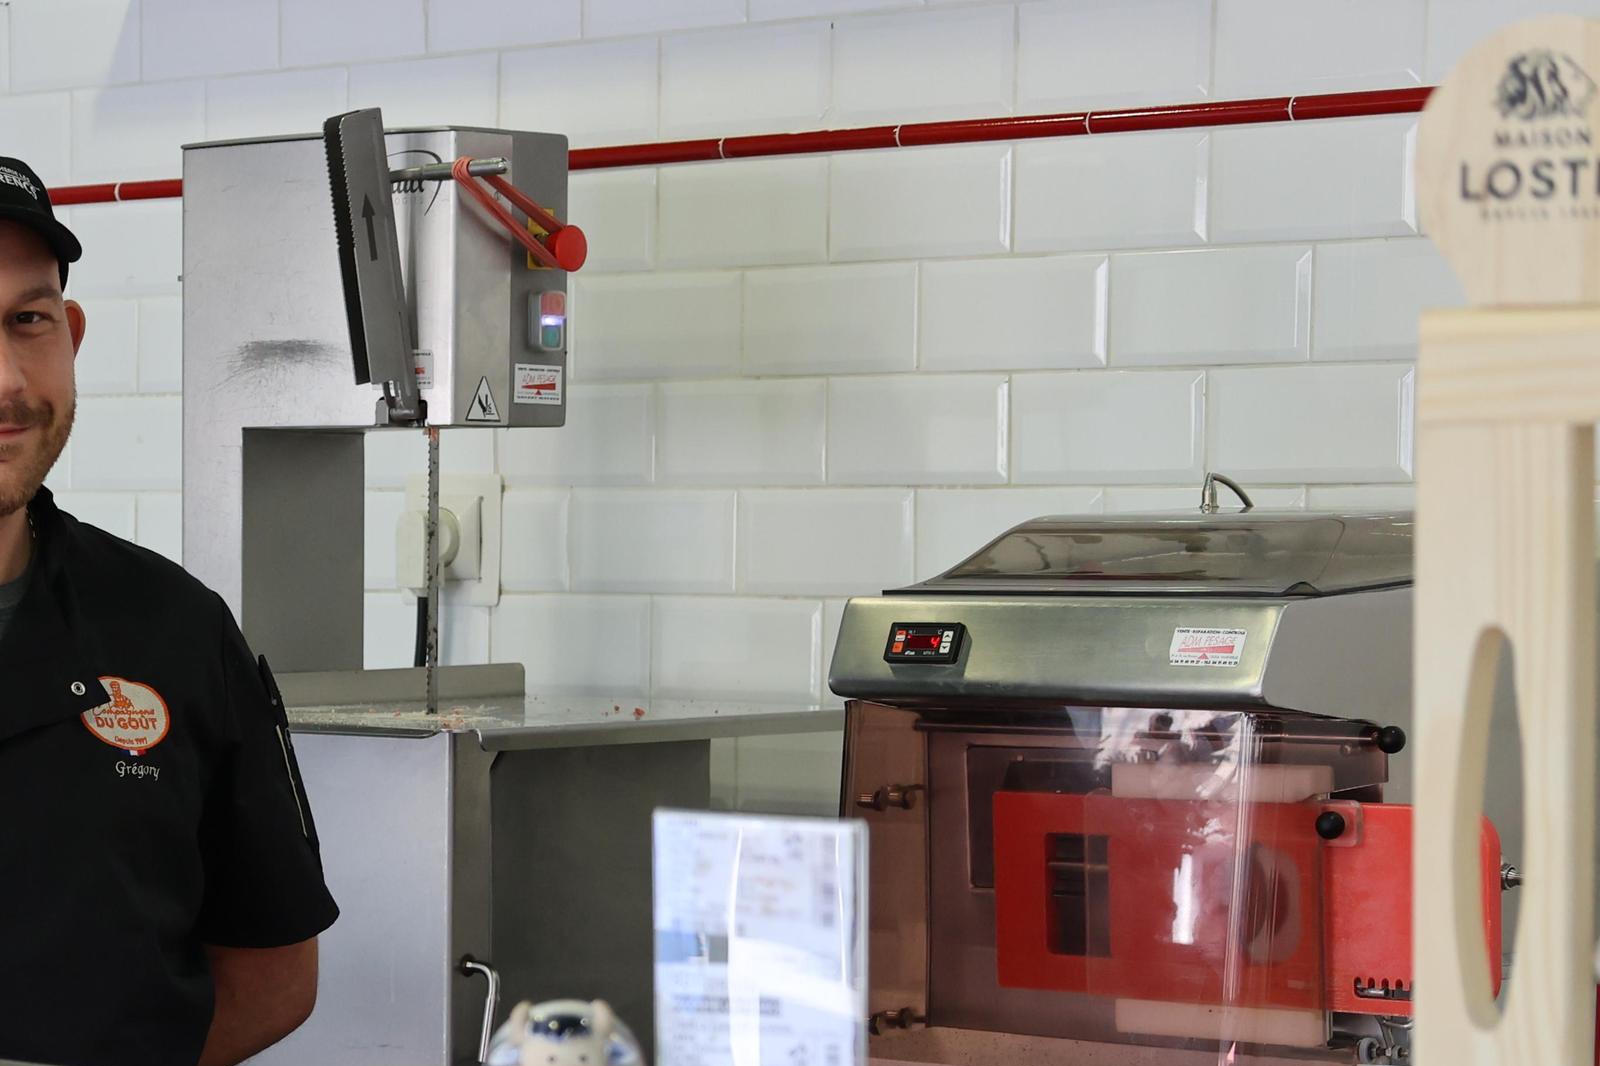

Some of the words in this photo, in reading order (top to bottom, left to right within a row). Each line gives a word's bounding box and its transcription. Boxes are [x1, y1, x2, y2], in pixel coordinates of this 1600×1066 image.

[1494, 128, 1591, 148] MAISON
[1460, 158, 1600, 201] LOST
[96, 717, 114, 728] DU
[117, 715, 157, 730] GOÛT
[115, 761, 160, 781] Grégory
